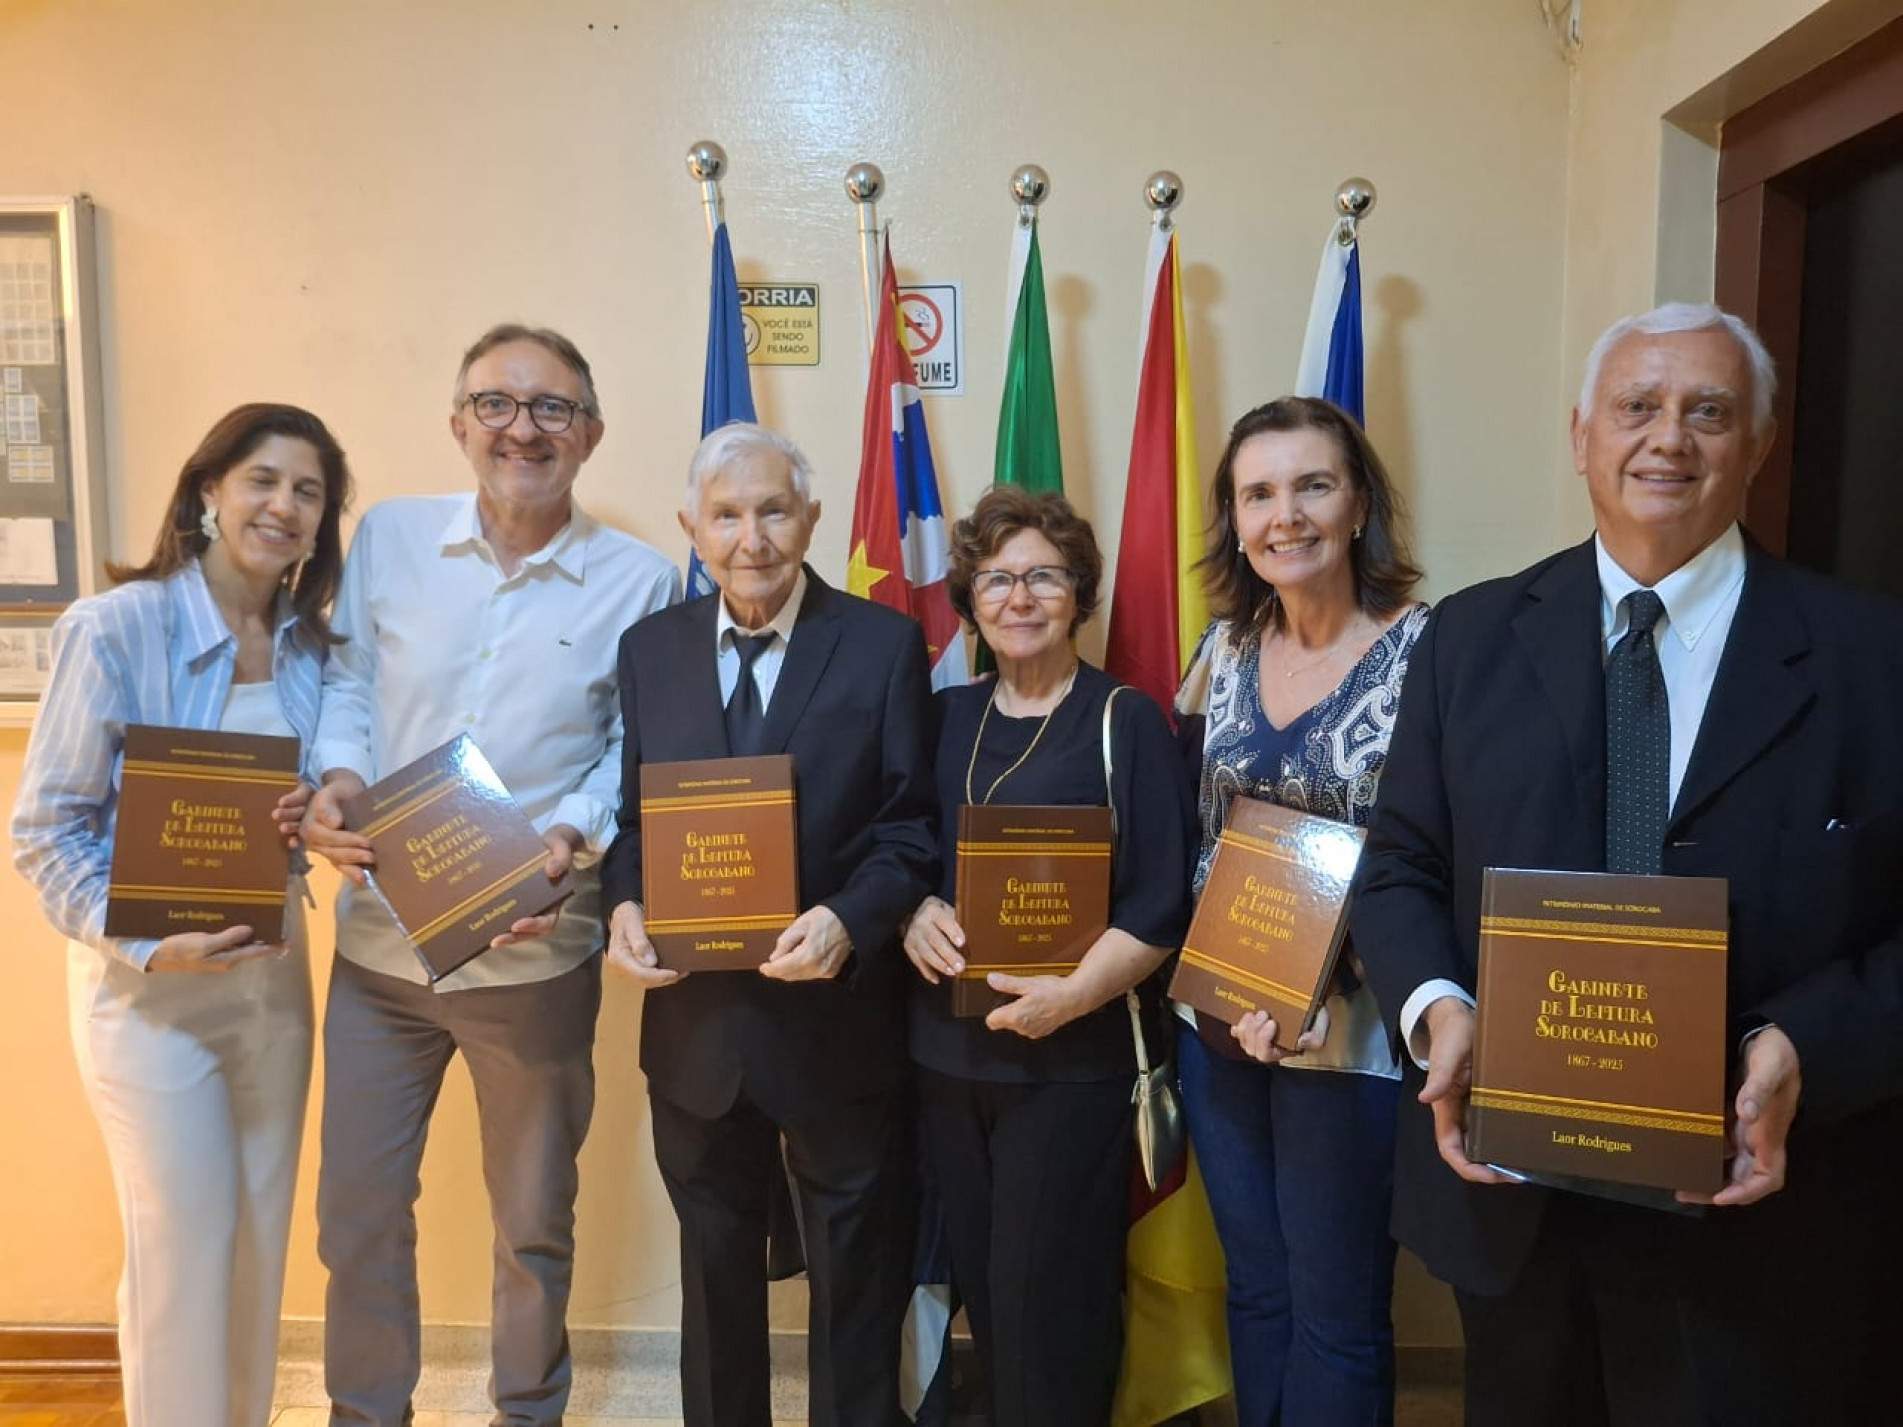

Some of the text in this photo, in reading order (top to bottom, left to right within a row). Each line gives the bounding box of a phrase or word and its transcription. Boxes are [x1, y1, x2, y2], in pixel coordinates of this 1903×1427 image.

[767, 344, 809, 354] FILMADO
[772, 332, 804, 341] SENDO
[1548, 969, 1648, 1000] GABINETE
[1541, 996, 1654, 1024] DE LEITURA
[1535, 1015, 1659, 1049] SOROCABANO
[1551, 1130, 1632, 1153] Laor Rodrigues
